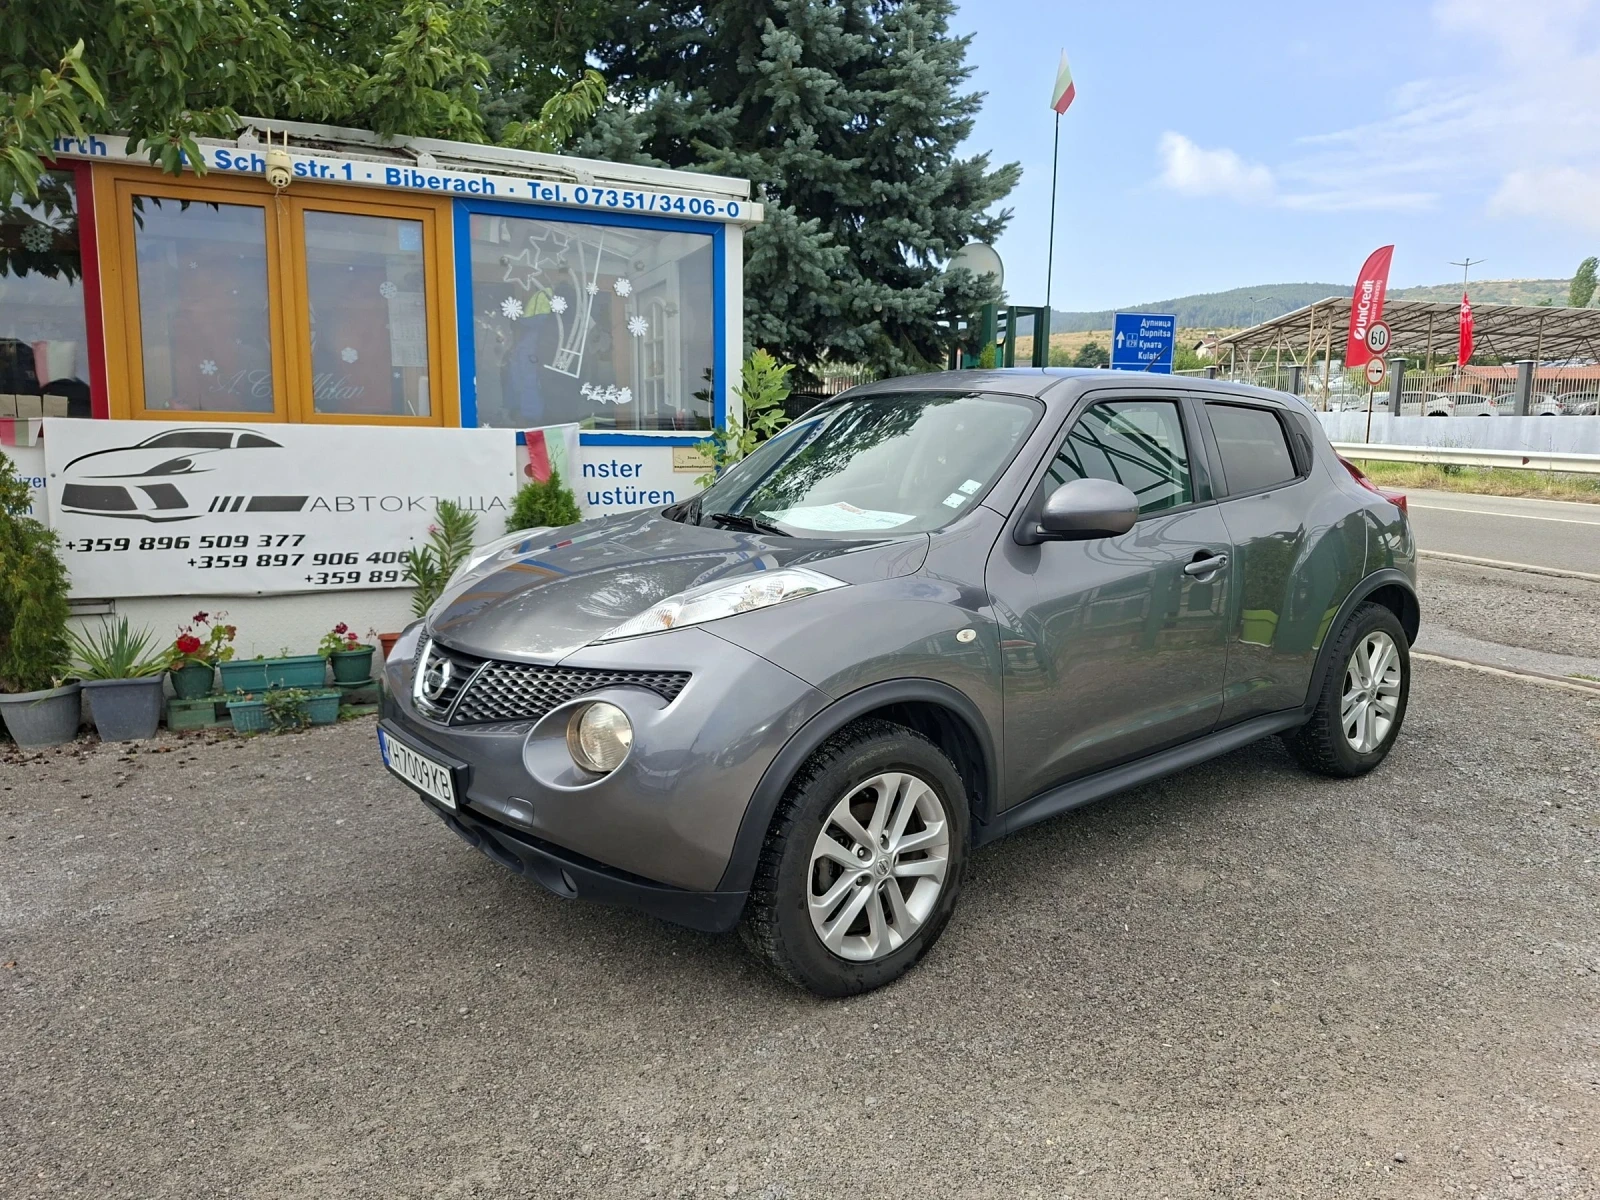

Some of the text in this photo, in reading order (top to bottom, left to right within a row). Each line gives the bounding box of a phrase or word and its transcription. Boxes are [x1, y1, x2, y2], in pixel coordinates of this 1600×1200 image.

[214, 149, 335, 180] Schstr.
[385, 167, 496, 195] Biberach
[527, 181, 568, 203] Tel.
[574, 186, 740, 219] 07351/3406-0
[1356, 280, 1374, 327] UniCredit
[1140, 318, 1171, 328] Дупница
[1140, 328, 1171, 338] Dupnitsa
[1371, 331, 1385, 345] 60
[1139, 340, 1162, 350] Кулата
[65, 533, 306, 553] +359 896 509 377
[187, 550, 411, 569] +359 897 906 406
[304, 570, 361, 585] +359
